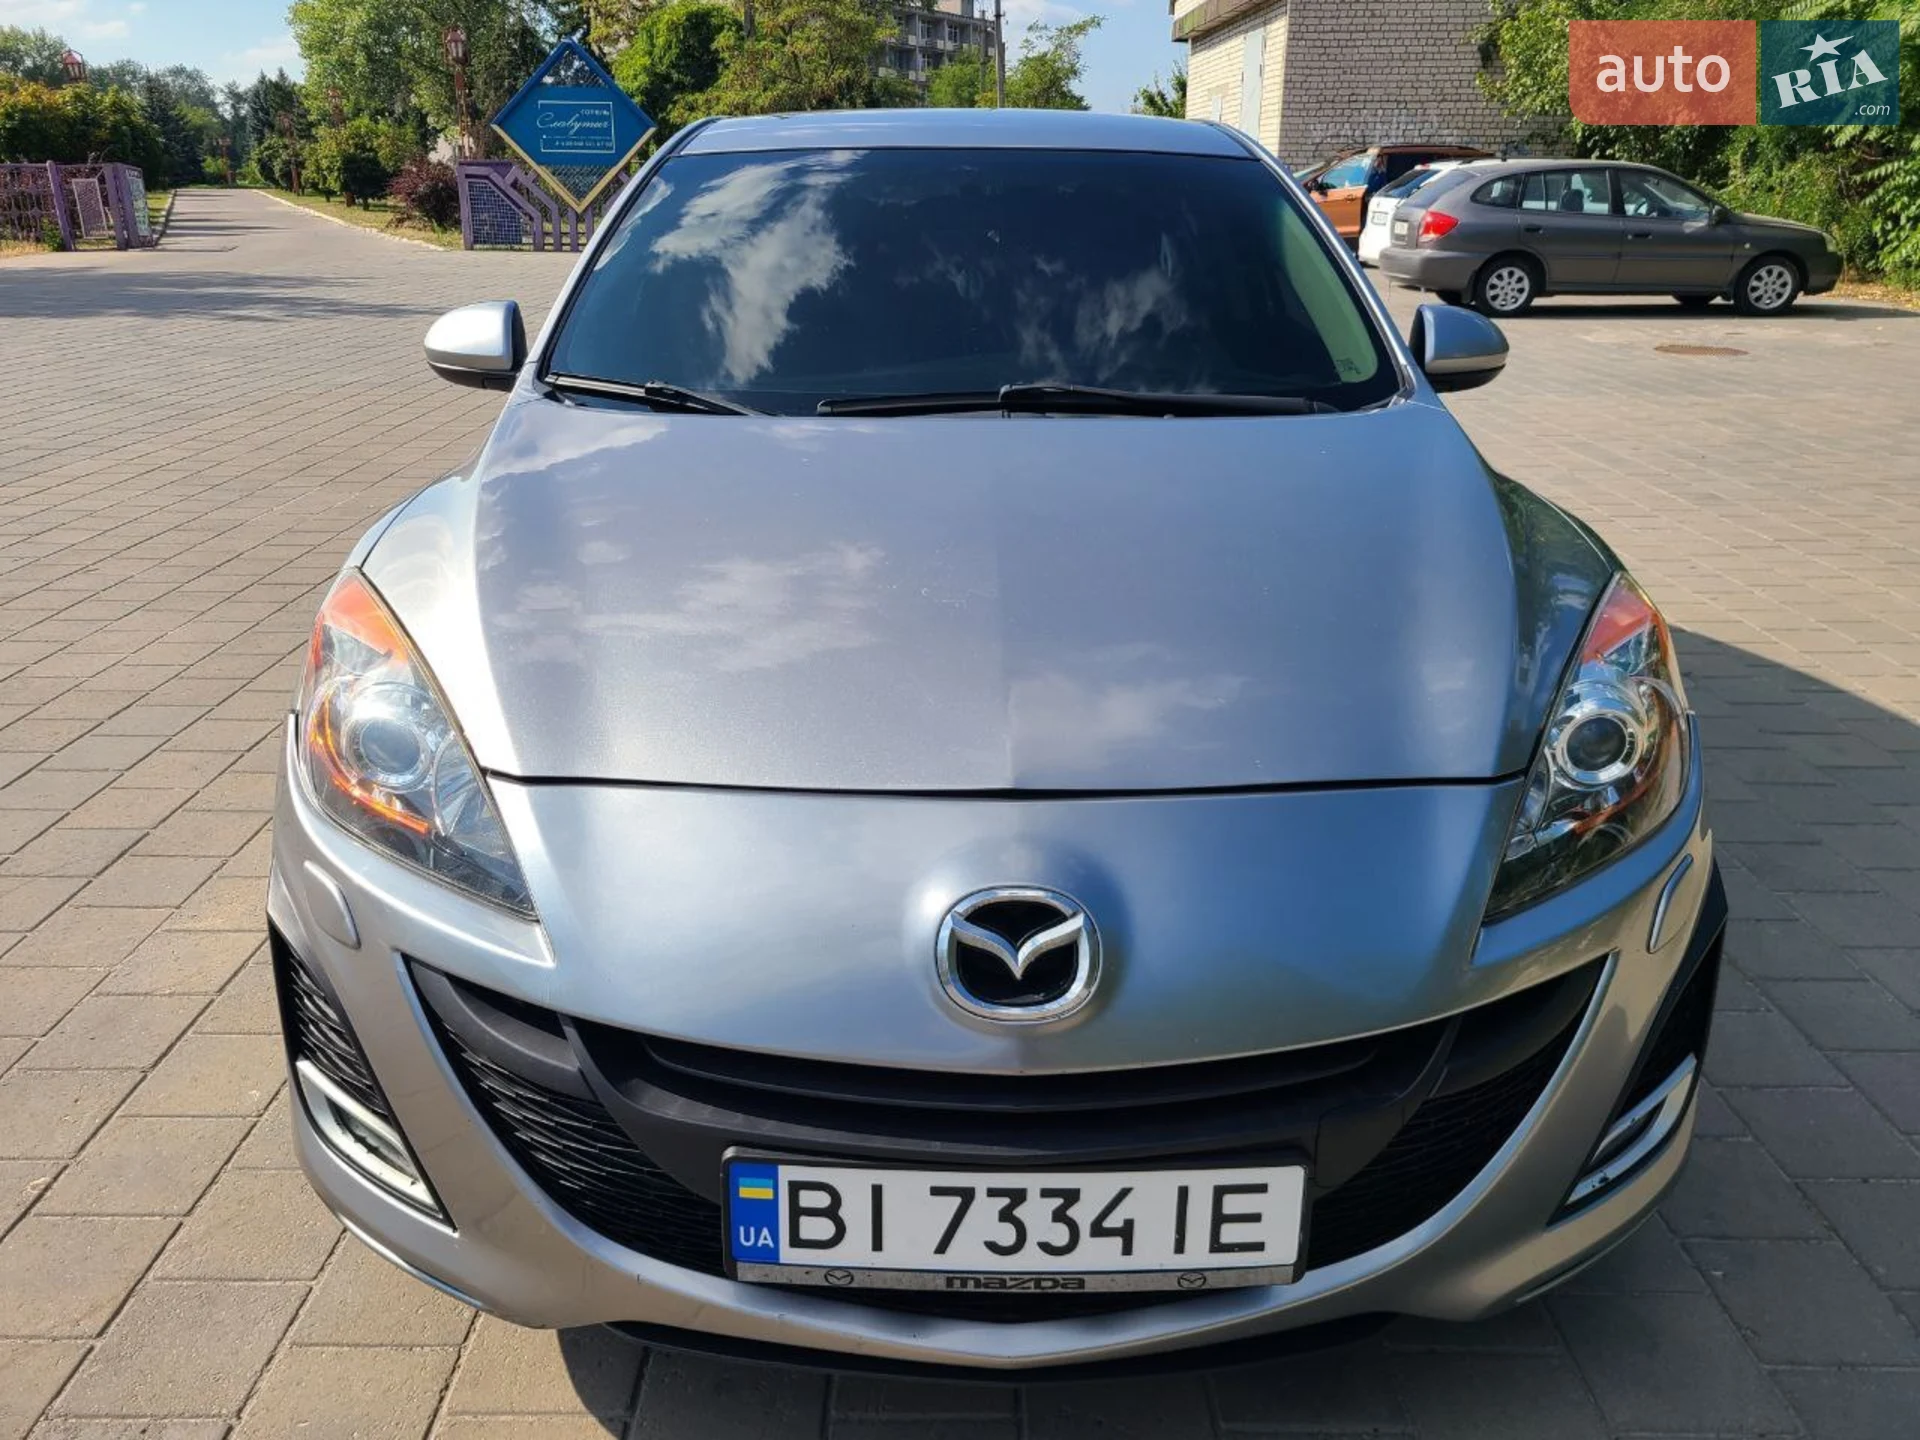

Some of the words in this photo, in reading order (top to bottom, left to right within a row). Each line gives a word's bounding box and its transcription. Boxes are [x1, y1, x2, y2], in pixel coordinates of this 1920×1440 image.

[739, 1225, 774, 1249] UA
[788, 1180, 884, 1252] BI
[929, 1186, 1135, 1256] 7334
[1174, 1183, 1269, 1255] IE
